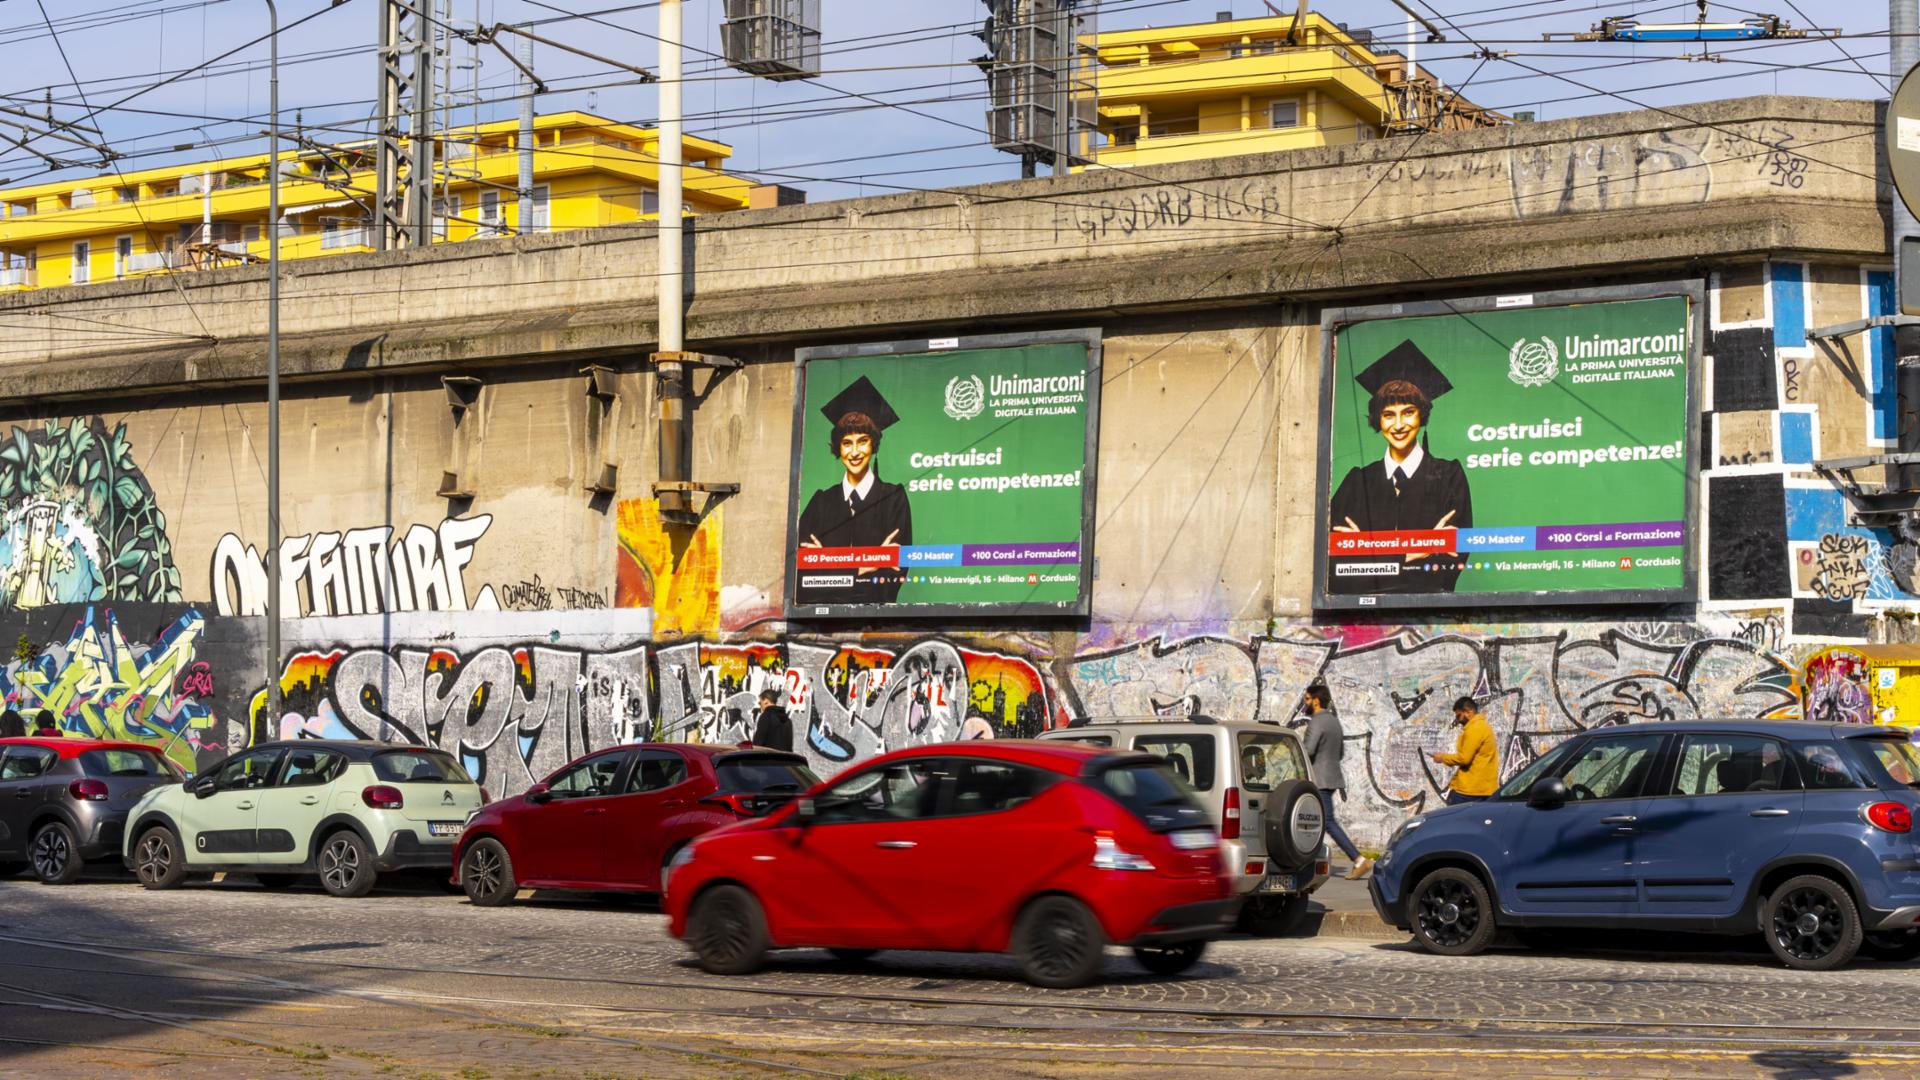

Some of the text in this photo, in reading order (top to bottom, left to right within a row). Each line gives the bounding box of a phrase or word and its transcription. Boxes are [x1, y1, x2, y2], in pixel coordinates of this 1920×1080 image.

[1565, 327, 1685, 359] Unimarconi
[1565, 354, 1684, 372] LA PRIMA UNIVERSITÀ
[990, 369, 1086, 396] Unimarconi
[1572, 368, 1675, 384] DIGITALE ITALIANA
[989, 392, 1084, 407] LA PRIMA UNIVERSITÀ
[995, 405, 1077, 418] DIGITALE ITALIANA
[1467, 416, 1583, 442] Costruisci
[910, 447, 1002, 468] Costruisci
[1466, 440, 1683, 469] serie competenze!
[908, 470, 1081, 493] serie competenze!
[1466, 534, 1525, 545] +50 Master
[1548, 533, 1572, 543] +100
[1574, 531, 1602, 543] Corsi
[1614, 529, 1681, 541] Formazione
[1337, 540, 1355, 549] +50
[1357, 538, 1400, 548] Percorsi
[1410, 538, 1446, 547] Laurea
[803, 555, 818, 563] +50
[820, 553, 854, 562] Percorsi
[862, 553, 891, 562] Laurea
[907, 551, 954, 561] +50 Master
[971, 551, 991, 560] +100
[993, 550, 1016, 560] Corsi
[1024, 549, 1077, 559] Formazione
[1495, 561, 1511, 571] Via
[1513, 559, 1561, 572] Meravigli,
[1563, 560, 1574, 570] 16
[1582, 558, 1616, 569] Milano
[1635, 557, 1681, 568] Cordusio
[1337, 565, 1397, 575] unimarconi.it
[803, 577, 852, 586] unimarconi.it
[929, 575, 942, 584] Via
[998, 574, 1025, 583] Milano
[1040, 573, 1076, 583] Cordusio
[1298, 813, 1320, 821] SUZUKI
